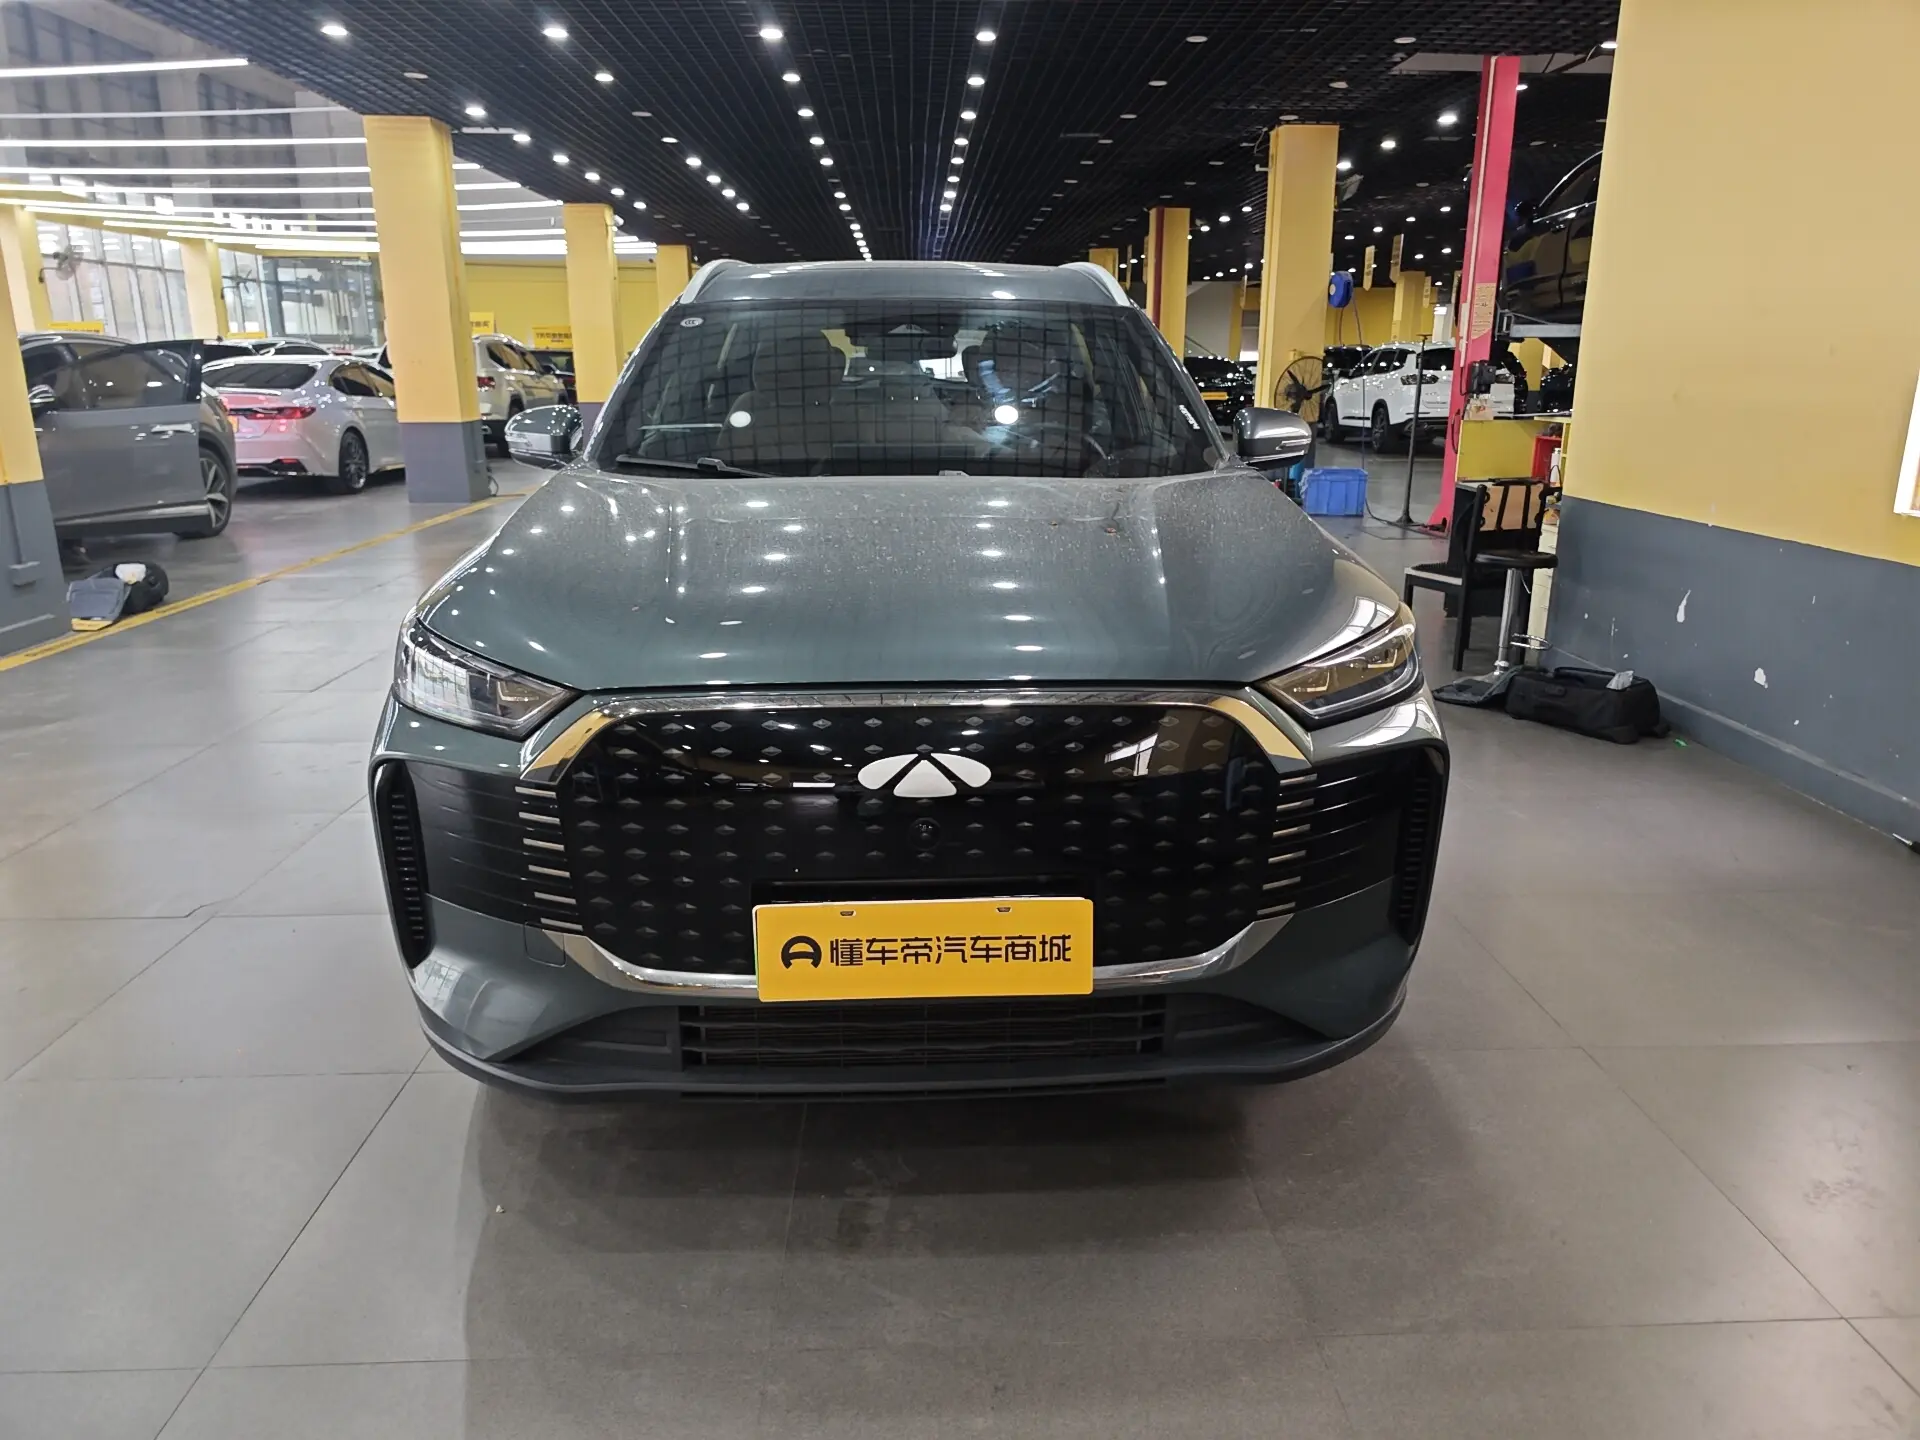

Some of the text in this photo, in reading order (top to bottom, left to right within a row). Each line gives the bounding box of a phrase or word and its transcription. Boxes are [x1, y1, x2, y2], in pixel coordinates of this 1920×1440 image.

[829, 934, 1072, 967] 懂车帝汽车商城
